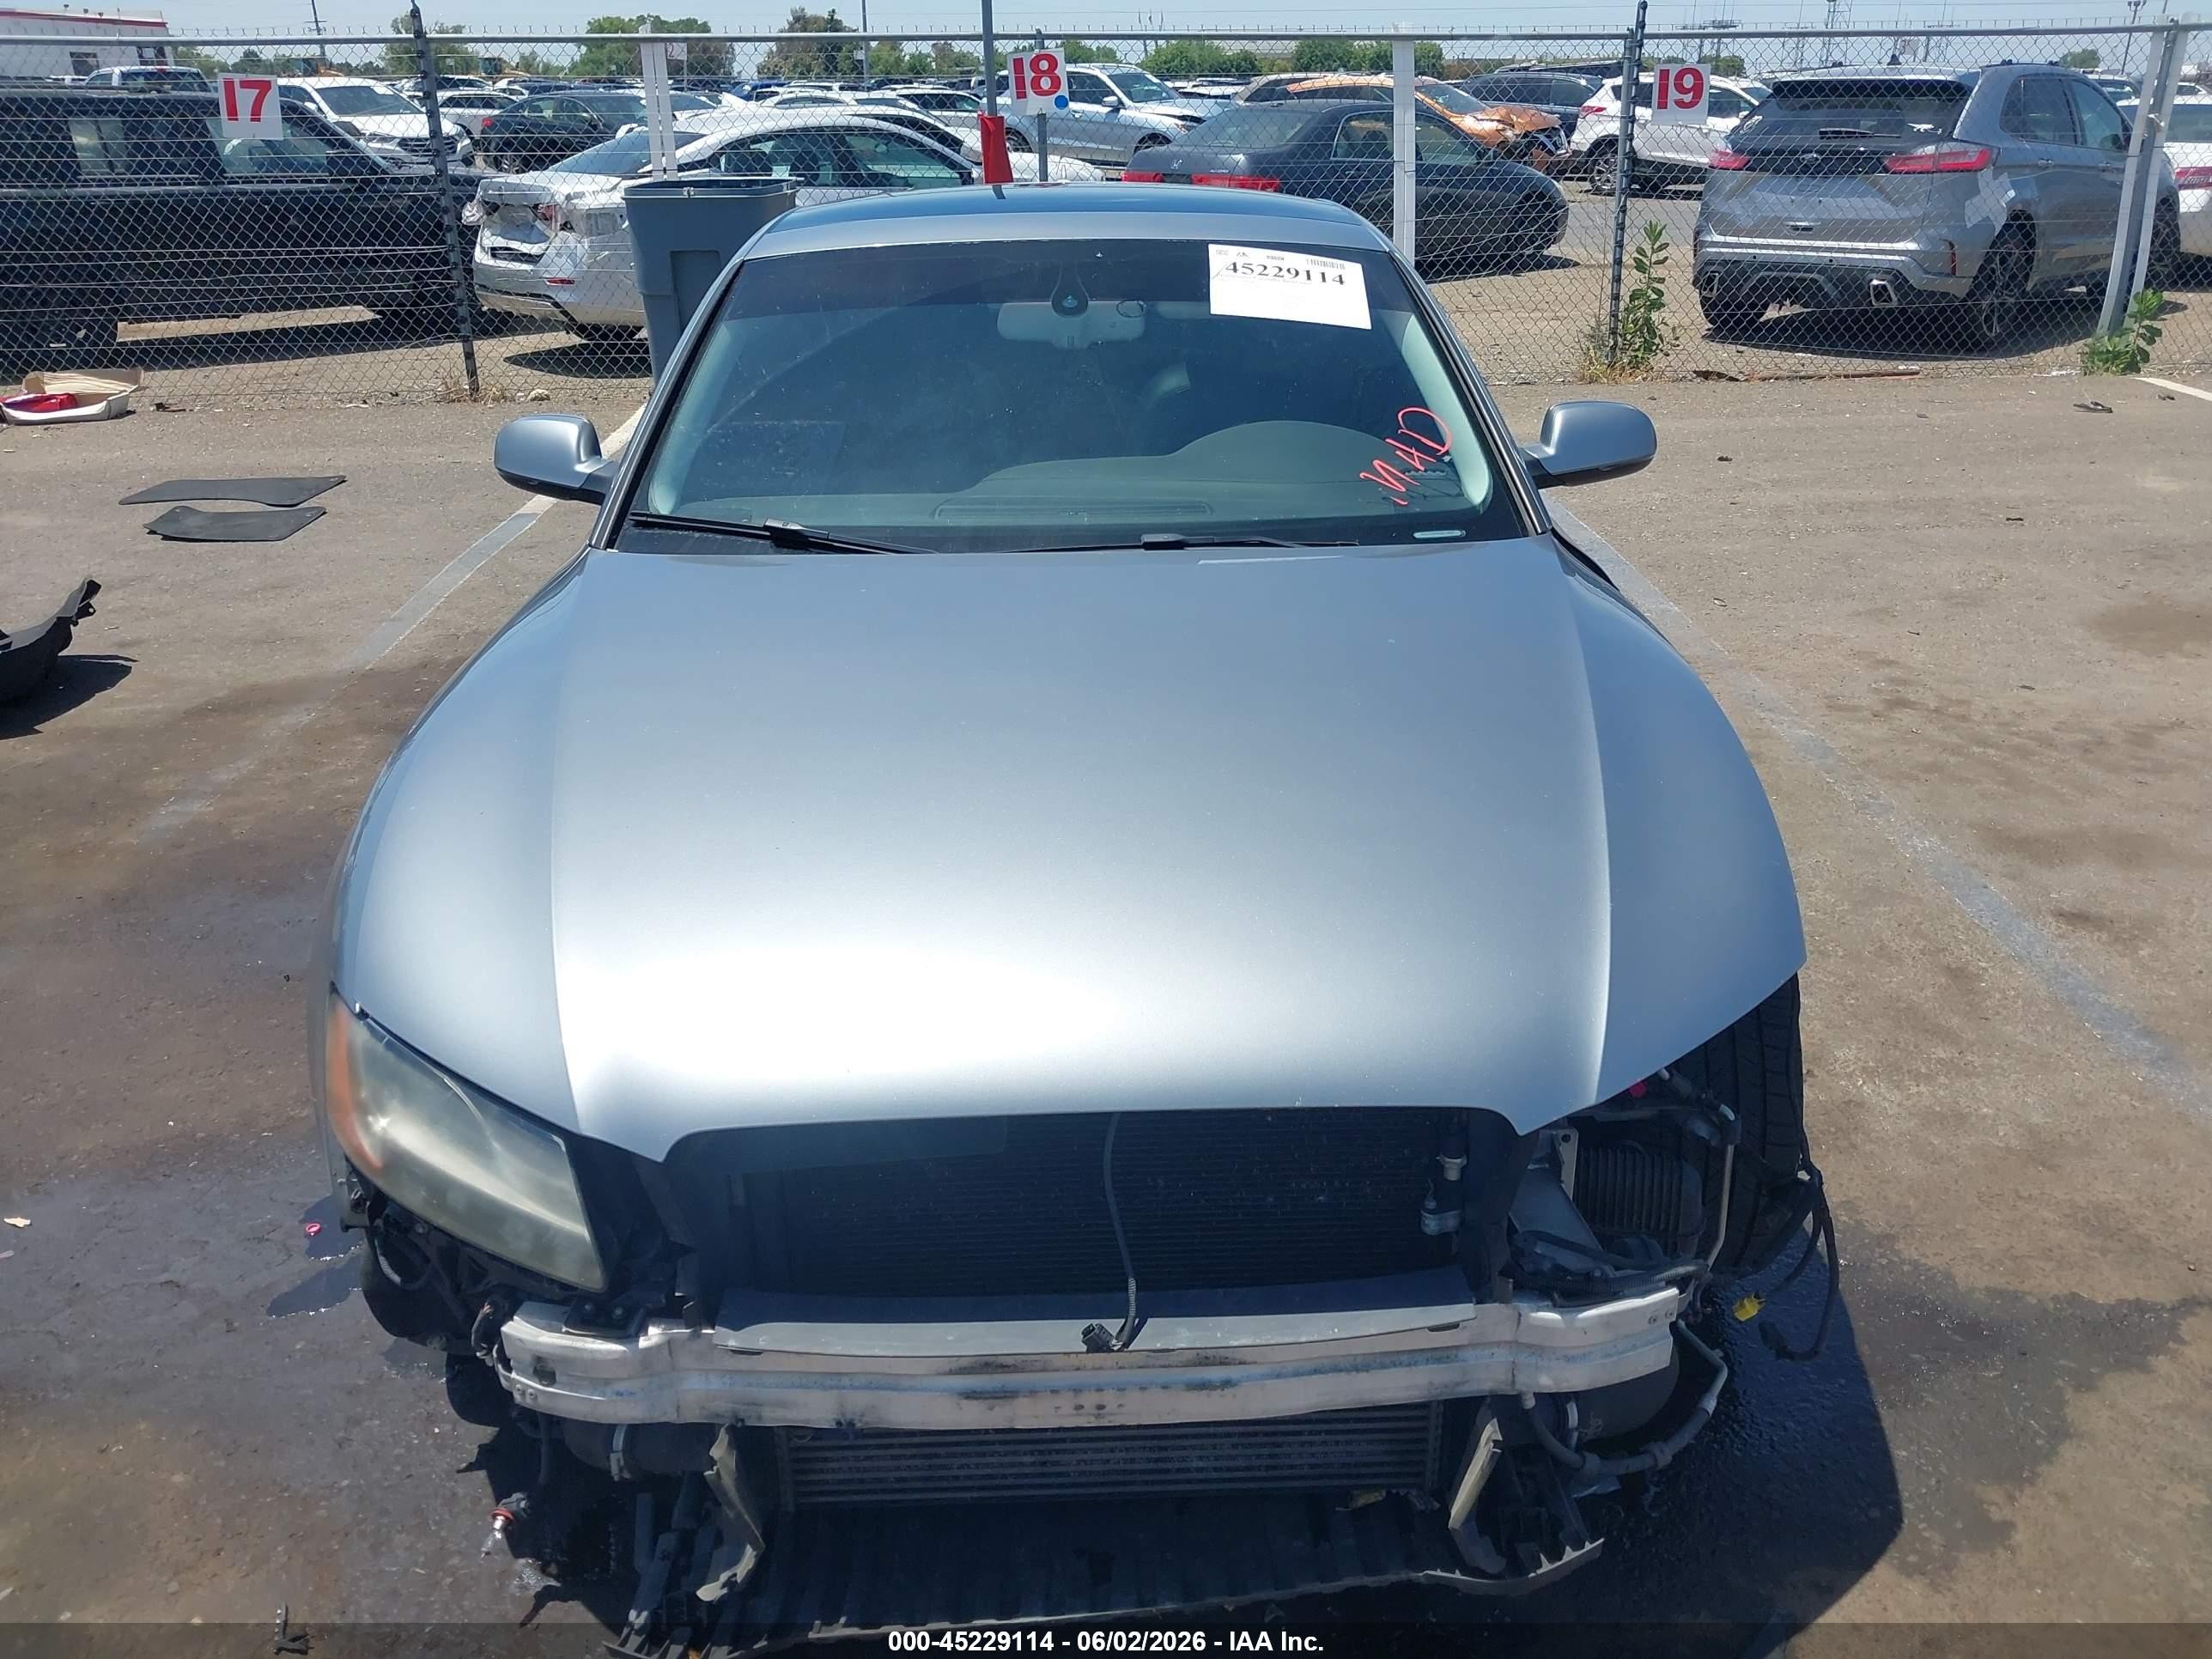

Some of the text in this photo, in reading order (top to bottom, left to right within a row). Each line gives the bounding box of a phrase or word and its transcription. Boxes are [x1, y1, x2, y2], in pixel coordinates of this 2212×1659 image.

[1012, 52, 1062, 100] 18
[1656, 66, 1705, 111] 19
[222, 77, 272, 123] 17
[1224, 261, 1346, 286] 45229114
